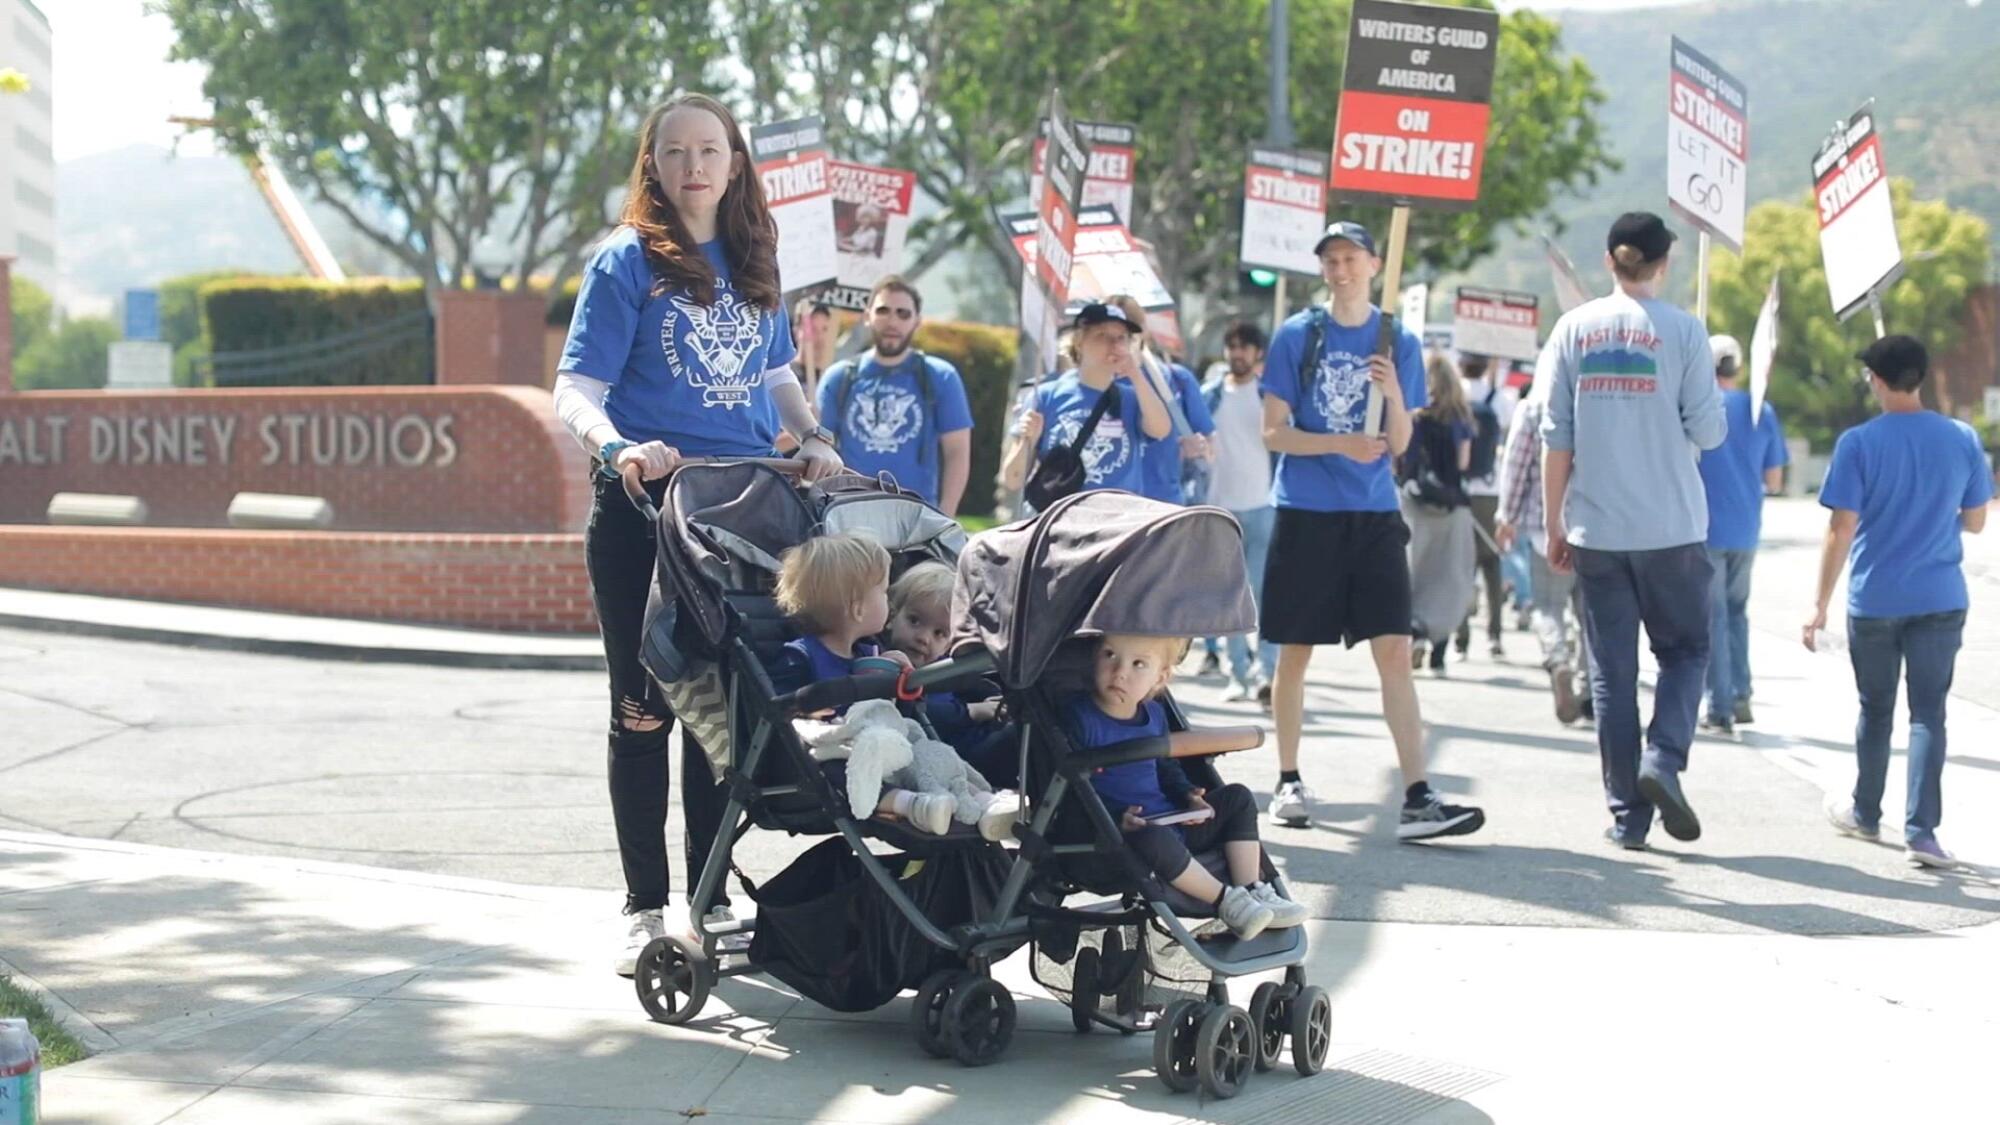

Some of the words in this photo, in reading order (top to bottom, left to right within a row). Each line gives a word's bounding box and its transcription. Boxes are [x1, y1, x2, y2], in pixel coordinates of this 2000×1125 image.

[1358, 18, 1435, 44] WRITERS
[1437, 27, 1488, 49] GUILD
[1377, 68, 1456, 92] AMERICA
[1410, 49, 1431, 66] OF
[1397, 108, 1430, 133] ON
[1674, 81, 1743, 155] STRIKE!
[1340, 132, 1475, 180] STRIKE!
[1678, 130, 1711, 165] LET
[1720, 156, 1741, 184] IT
[762, 157, 826, 202] STRIKE!
[1250, 174, 1321, 208] STRIKE!
[1687, 173, 1724, 214] GO
[1819, 145, 1880, 223] STRIKE!
[661, 310, 685, 378] WRITERS
[0, 416, 66, 464] ALT
[89, 415, 237, 464] DISNEY
[259, 414, 458, 467] STUDIOS
